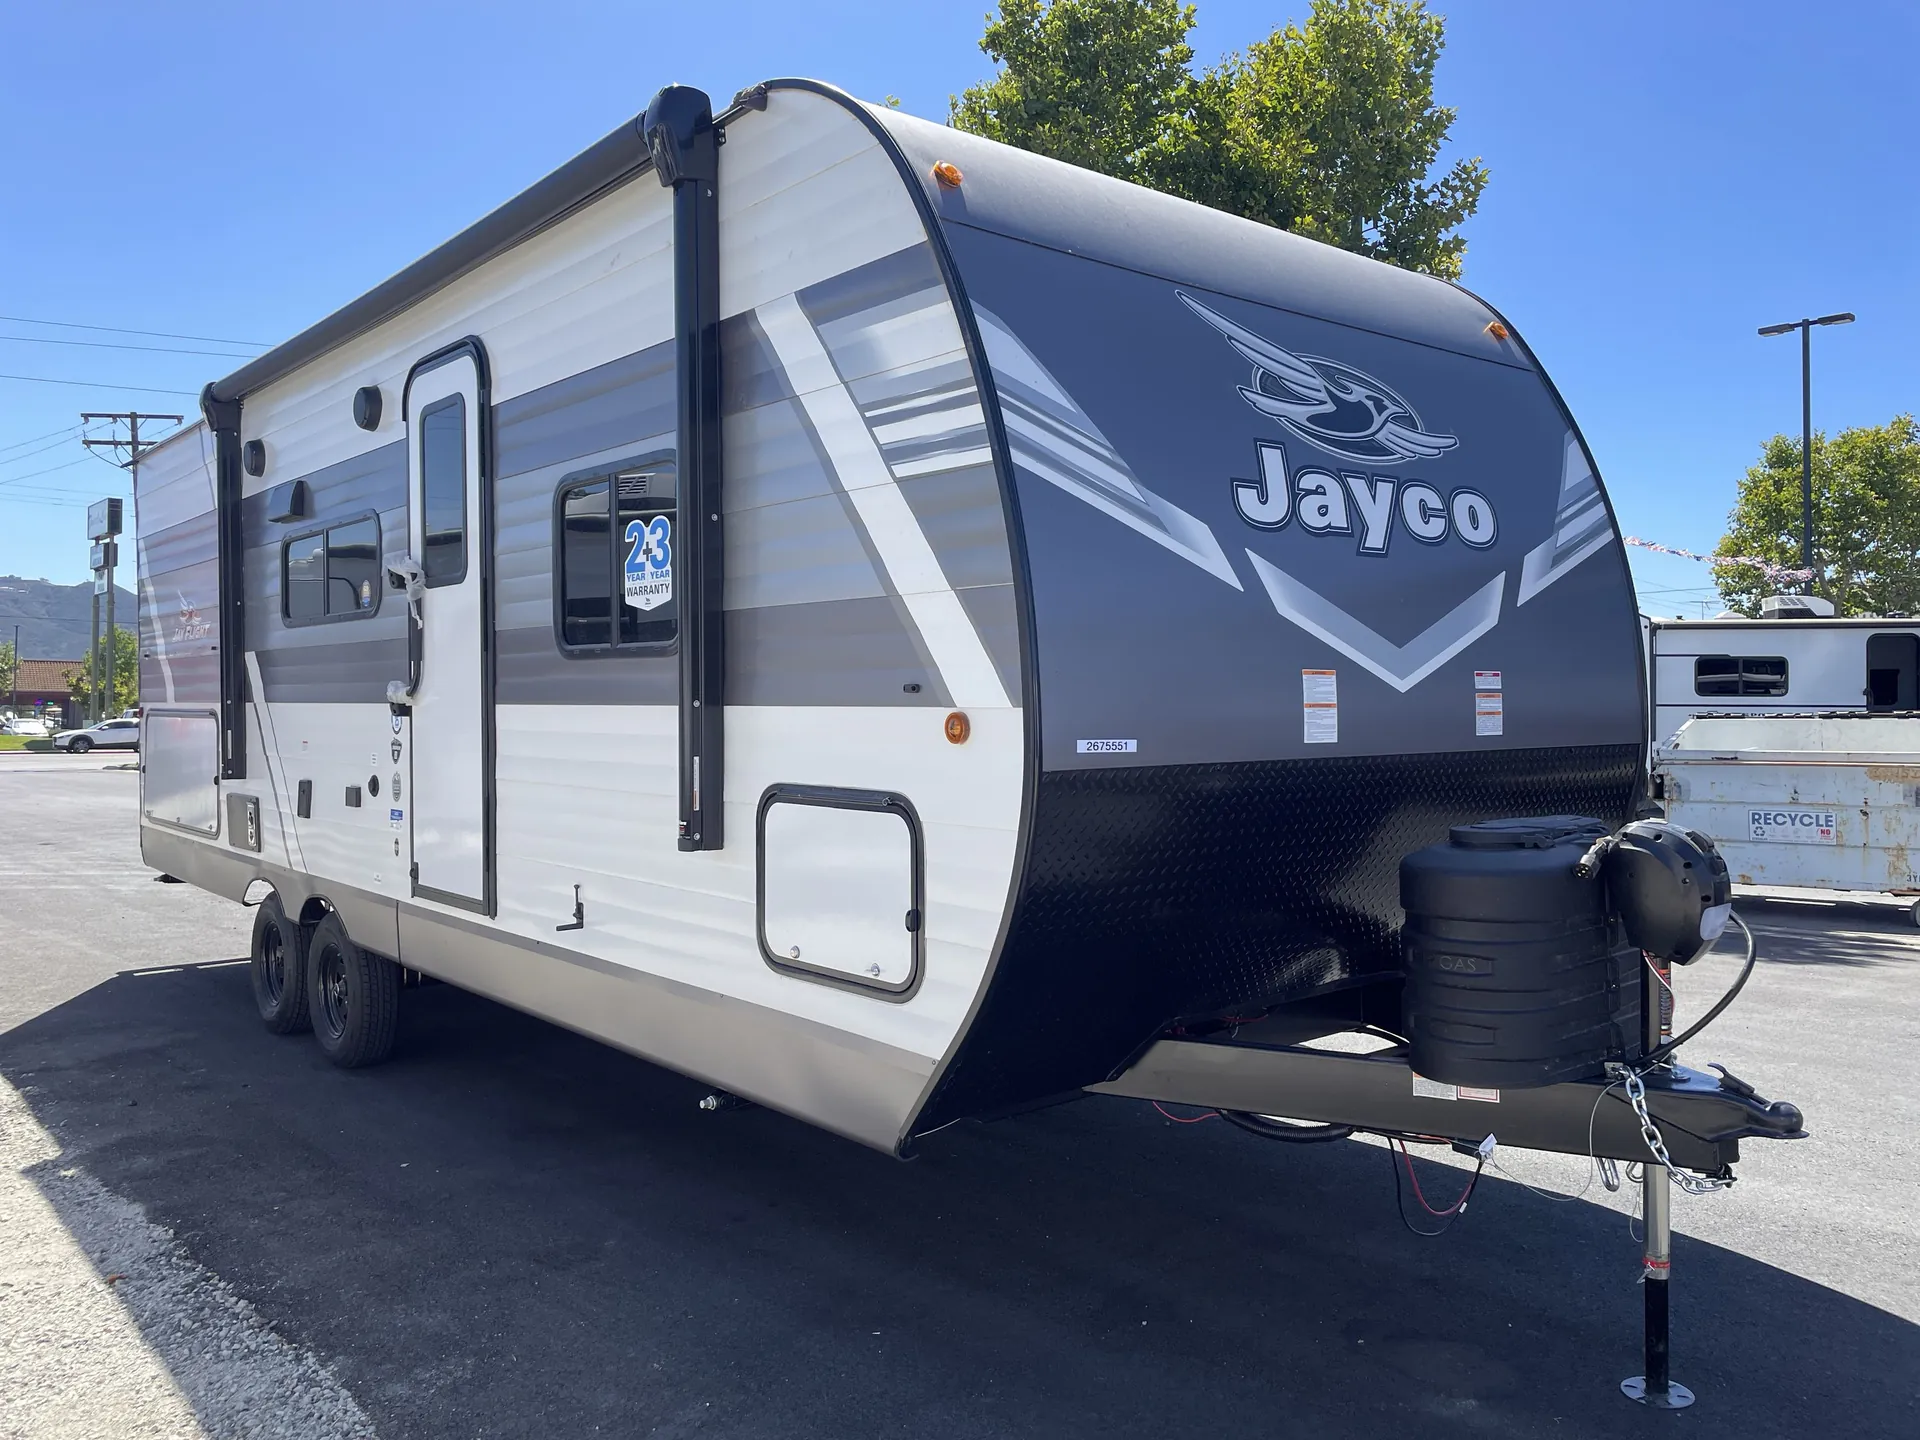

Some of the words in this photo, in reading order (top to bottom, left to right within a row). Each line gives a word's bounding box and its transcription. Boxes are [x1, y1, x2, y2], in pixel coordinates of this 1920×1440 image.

[1231, 440, 1499, 556] Jayco
[626, 573, 646, 582] YEAR
[650, 569, 670, 579] YEAR
[626, 583, 670, 597] WARRANTY
[1086, 741, 1128, 751] 2675551
[1751, 812, 1834, 828] RECYCLE
[1820, 828, 1831, 836] NO
[1906, 874, 1920, 883] 3Y
[1440, 956, 1477, 972] GAS
